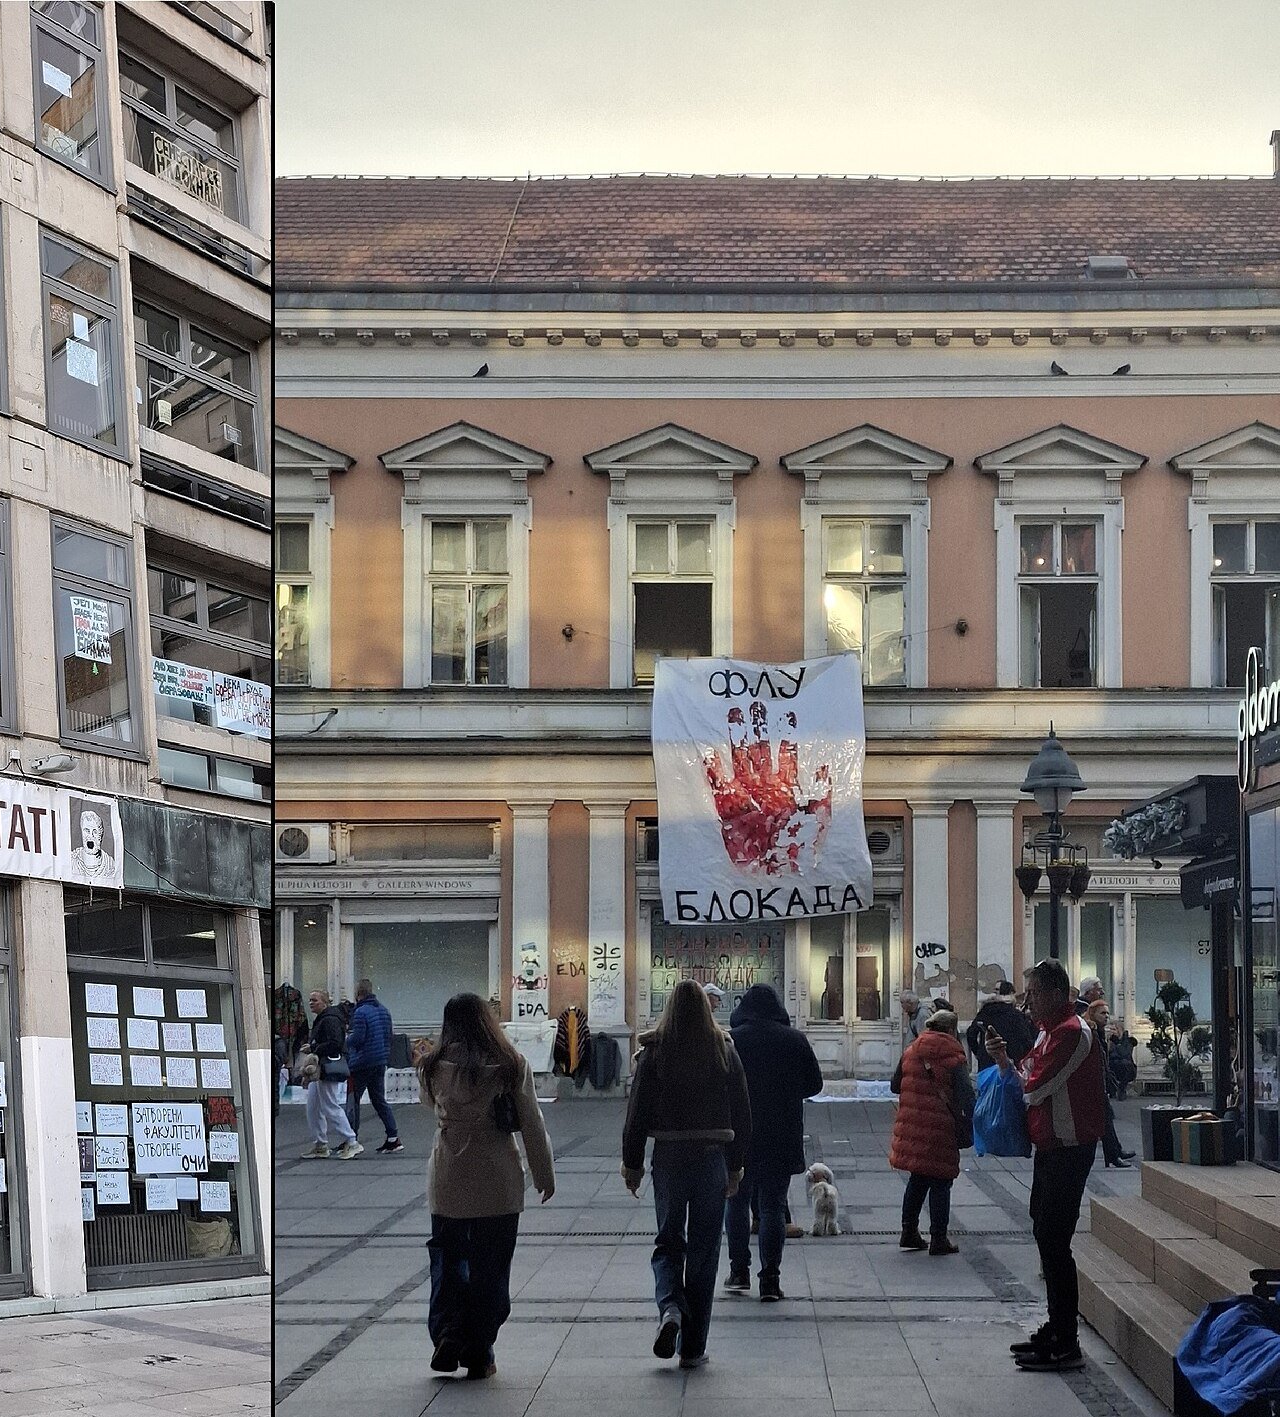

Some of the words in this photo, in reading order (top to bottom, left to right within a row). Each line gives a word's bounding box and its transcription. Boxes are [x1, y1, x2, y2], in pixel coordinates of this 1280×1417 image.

[708, 666, 807, 699] ФЛУ
[377, 880, 423, 889] GALLERY
[425, 880, 472, 889] WINDOWS
[675, 883, 865, 923] БЛОКАДА
[557, 962, 586, 978] EDA
[518, 1003, 548, 1017] EDA
[134, 1107, 183, 1123] ЗАТВОРЕНИ
[143, 1125, 202, 1140] ФАКУЛТЕТИ
[137, 1143, 182, 1157] ОТВОРЕНЕ
[181, 1155, 206, 1171] ОЧИ
